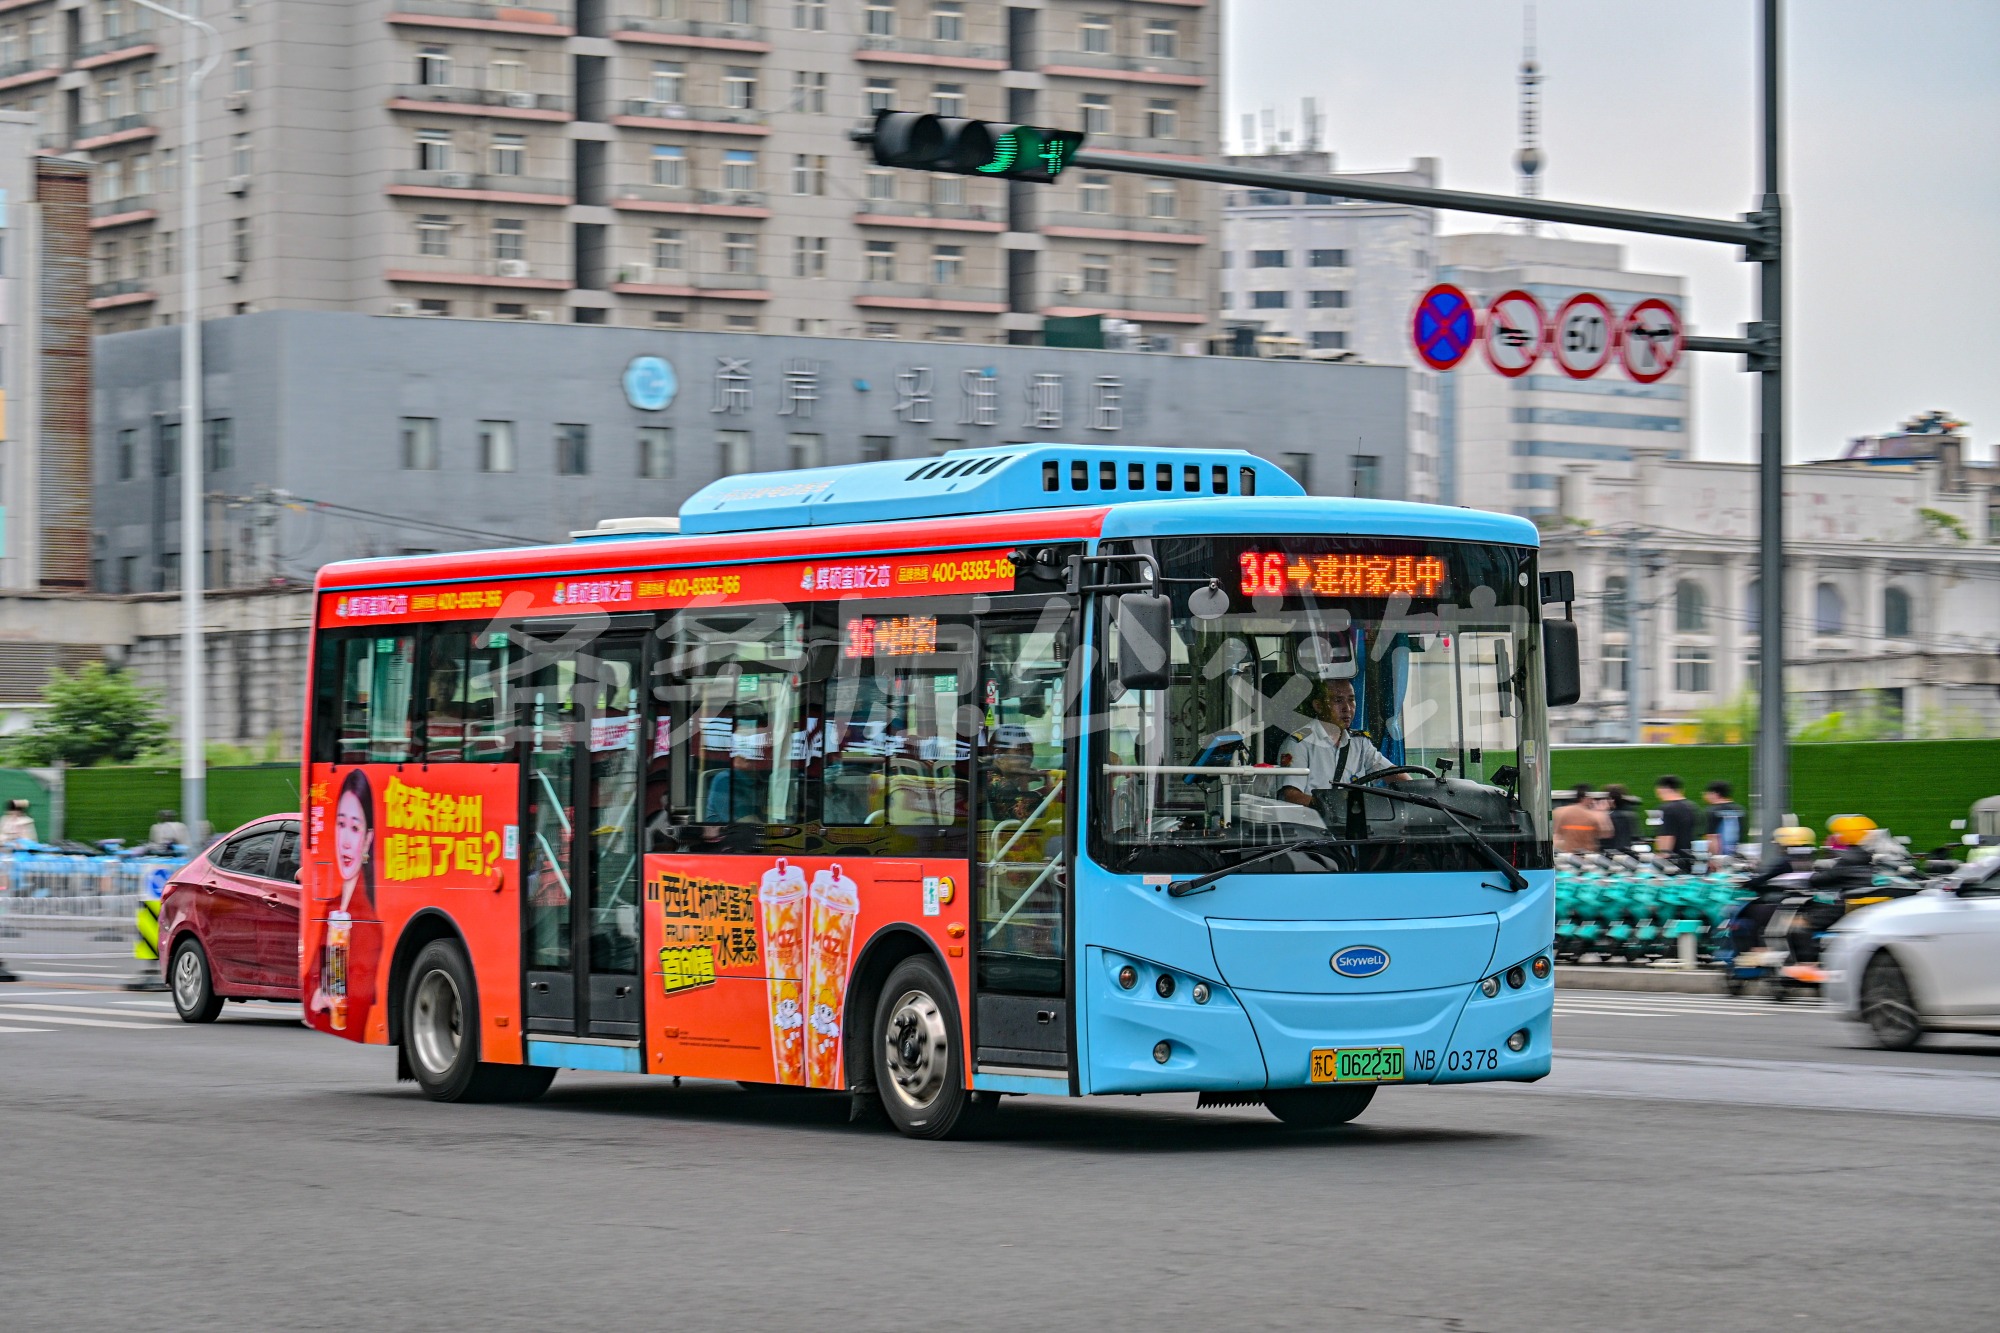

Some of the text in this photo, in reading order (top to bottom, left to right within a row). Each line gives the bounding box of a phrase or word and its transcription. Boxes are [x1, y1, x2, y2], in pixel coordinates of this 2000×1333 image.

[667, 575, 741, 597] 400-8383-166
[932, 558, 1015, 583] 400-8383-166
[1241, 553, 1441, 595] 36 建材家具中
[845, 618, 876, 657] 36
[383, 775, 484, 833] 你来徐州
[1413, 1048, 1498, 1071] NB 0378
